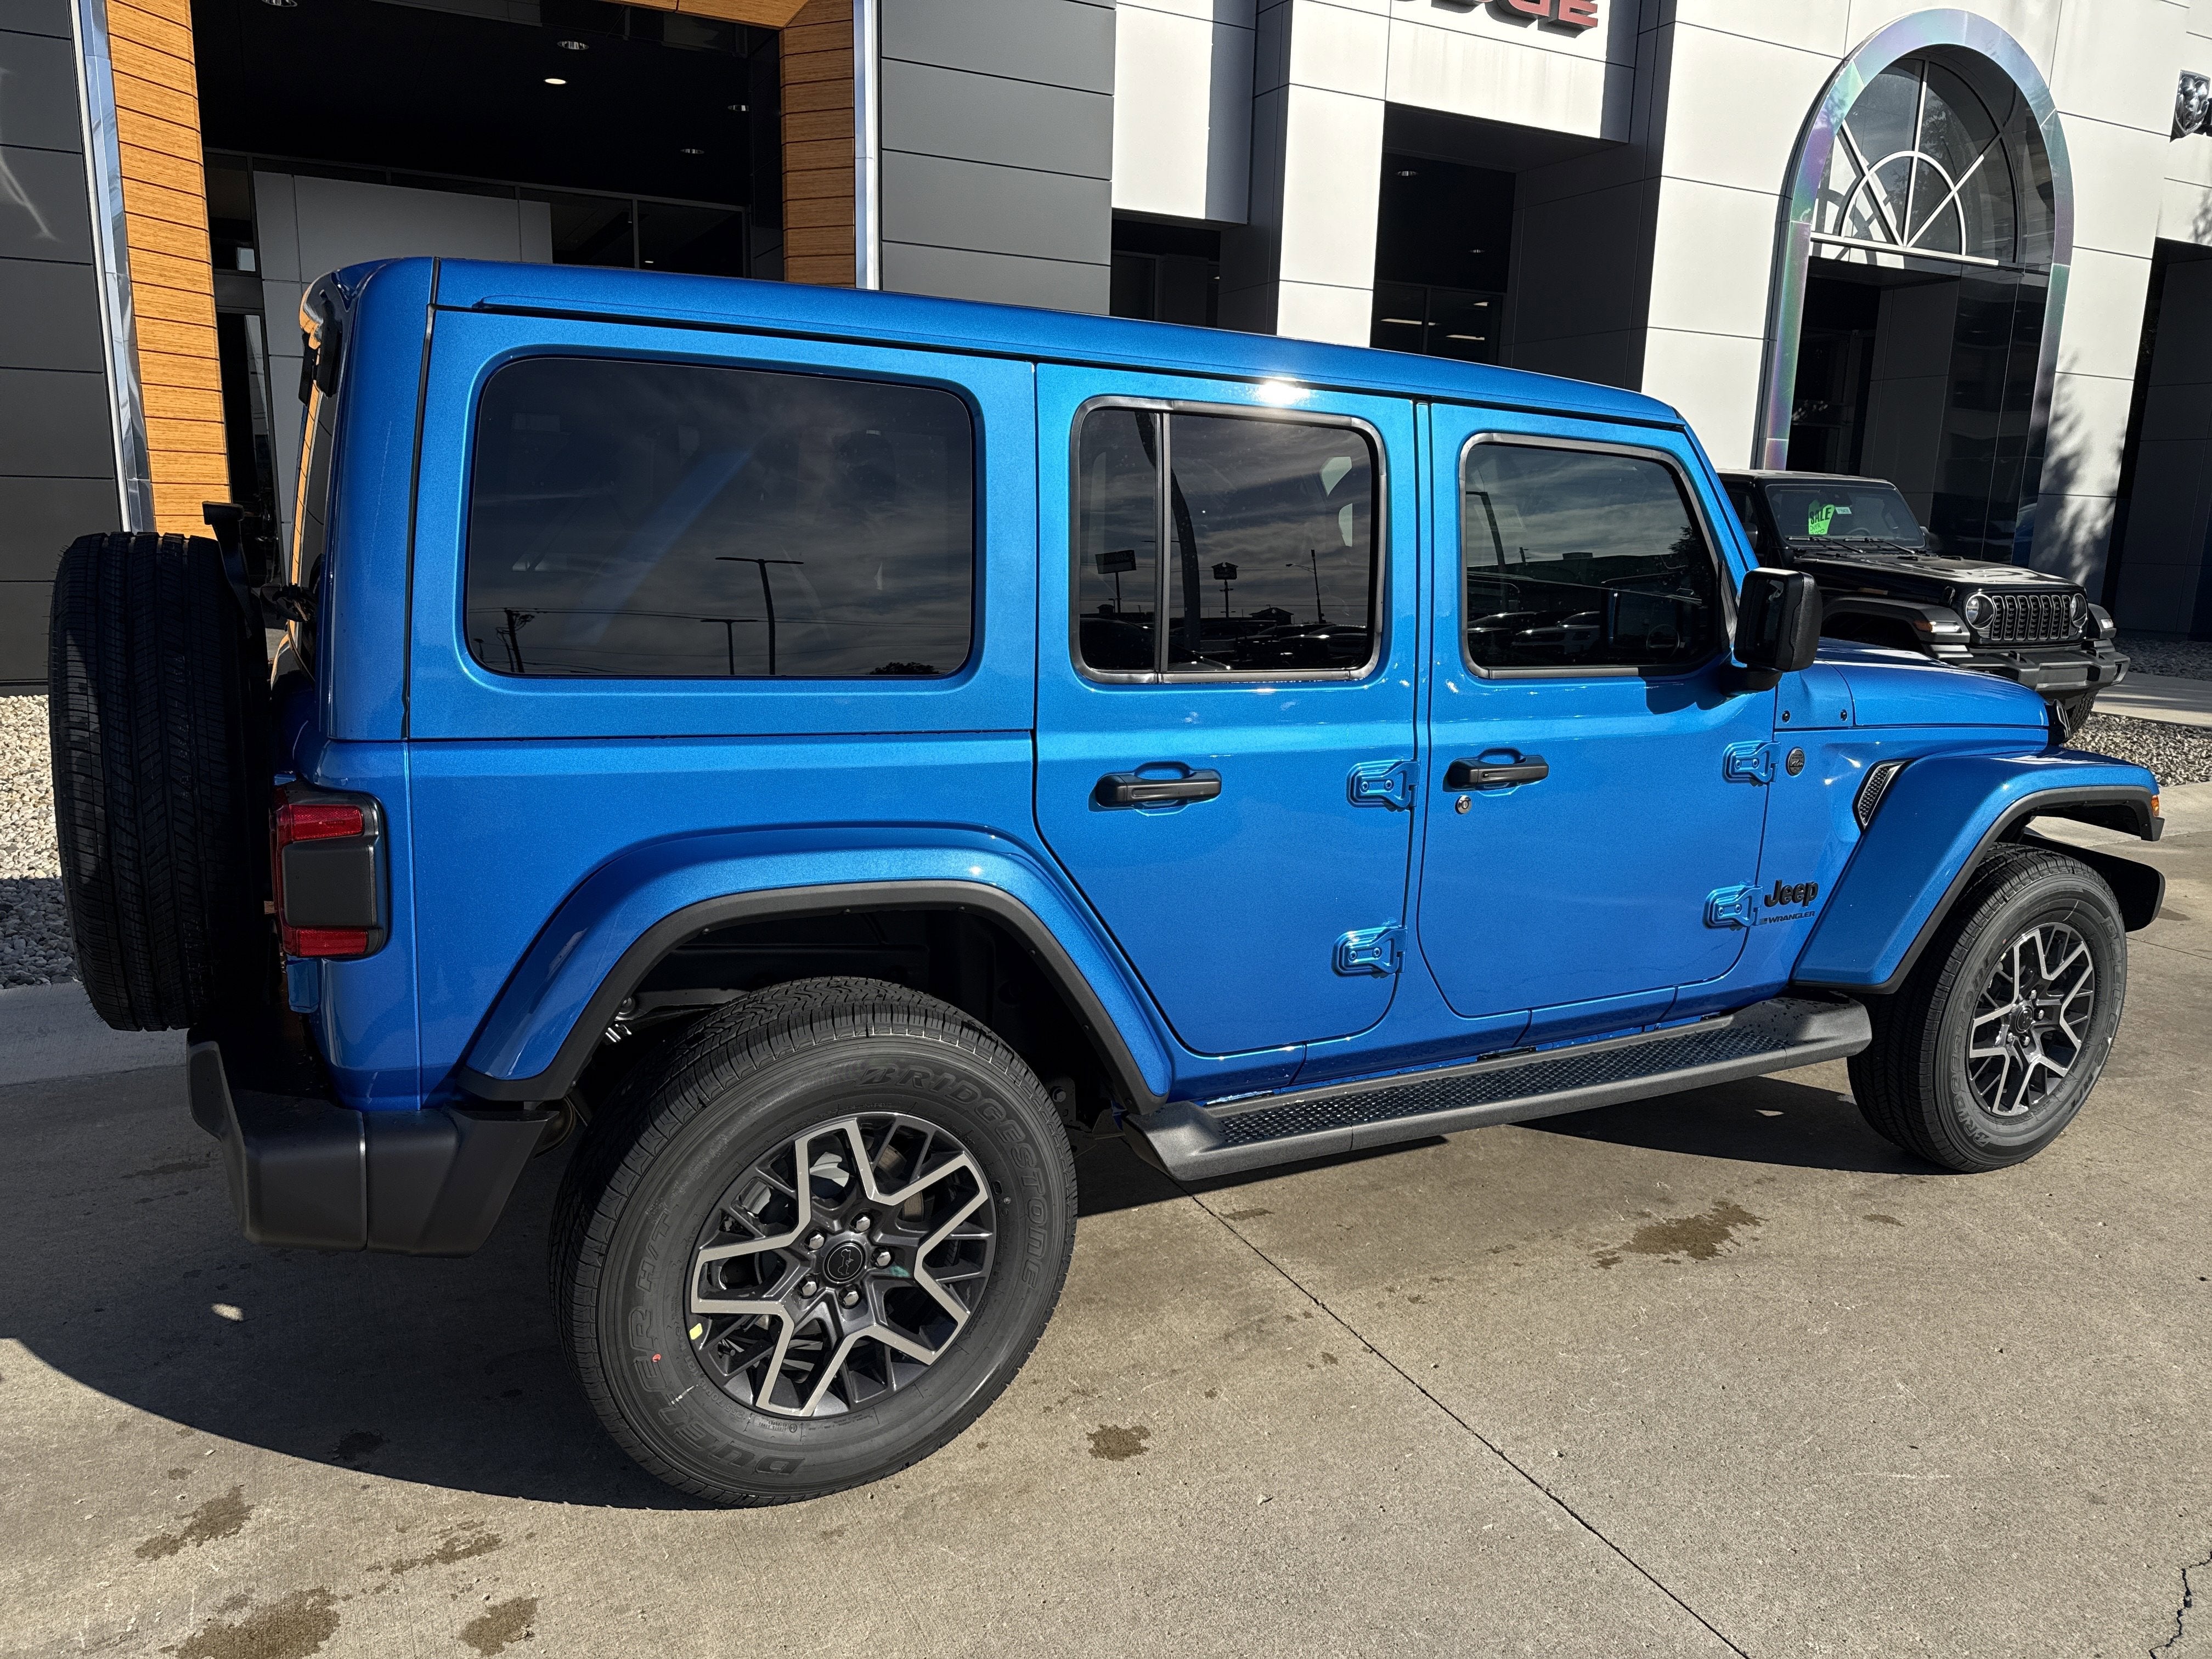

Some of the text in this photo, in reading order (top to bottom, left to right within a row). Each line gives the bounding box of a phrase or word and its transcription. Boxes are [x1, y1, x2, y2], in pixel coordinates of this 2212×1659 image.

[1810, 507, 1832, 524] SALE
[1764, 879, 1819, 907] Jeep
[1768, 910, 1815, 923] WRANGLER
[855, 1062, 1048, 1290] BRIDGESTONE
[629, 1306, 806, 1475] DUELER
